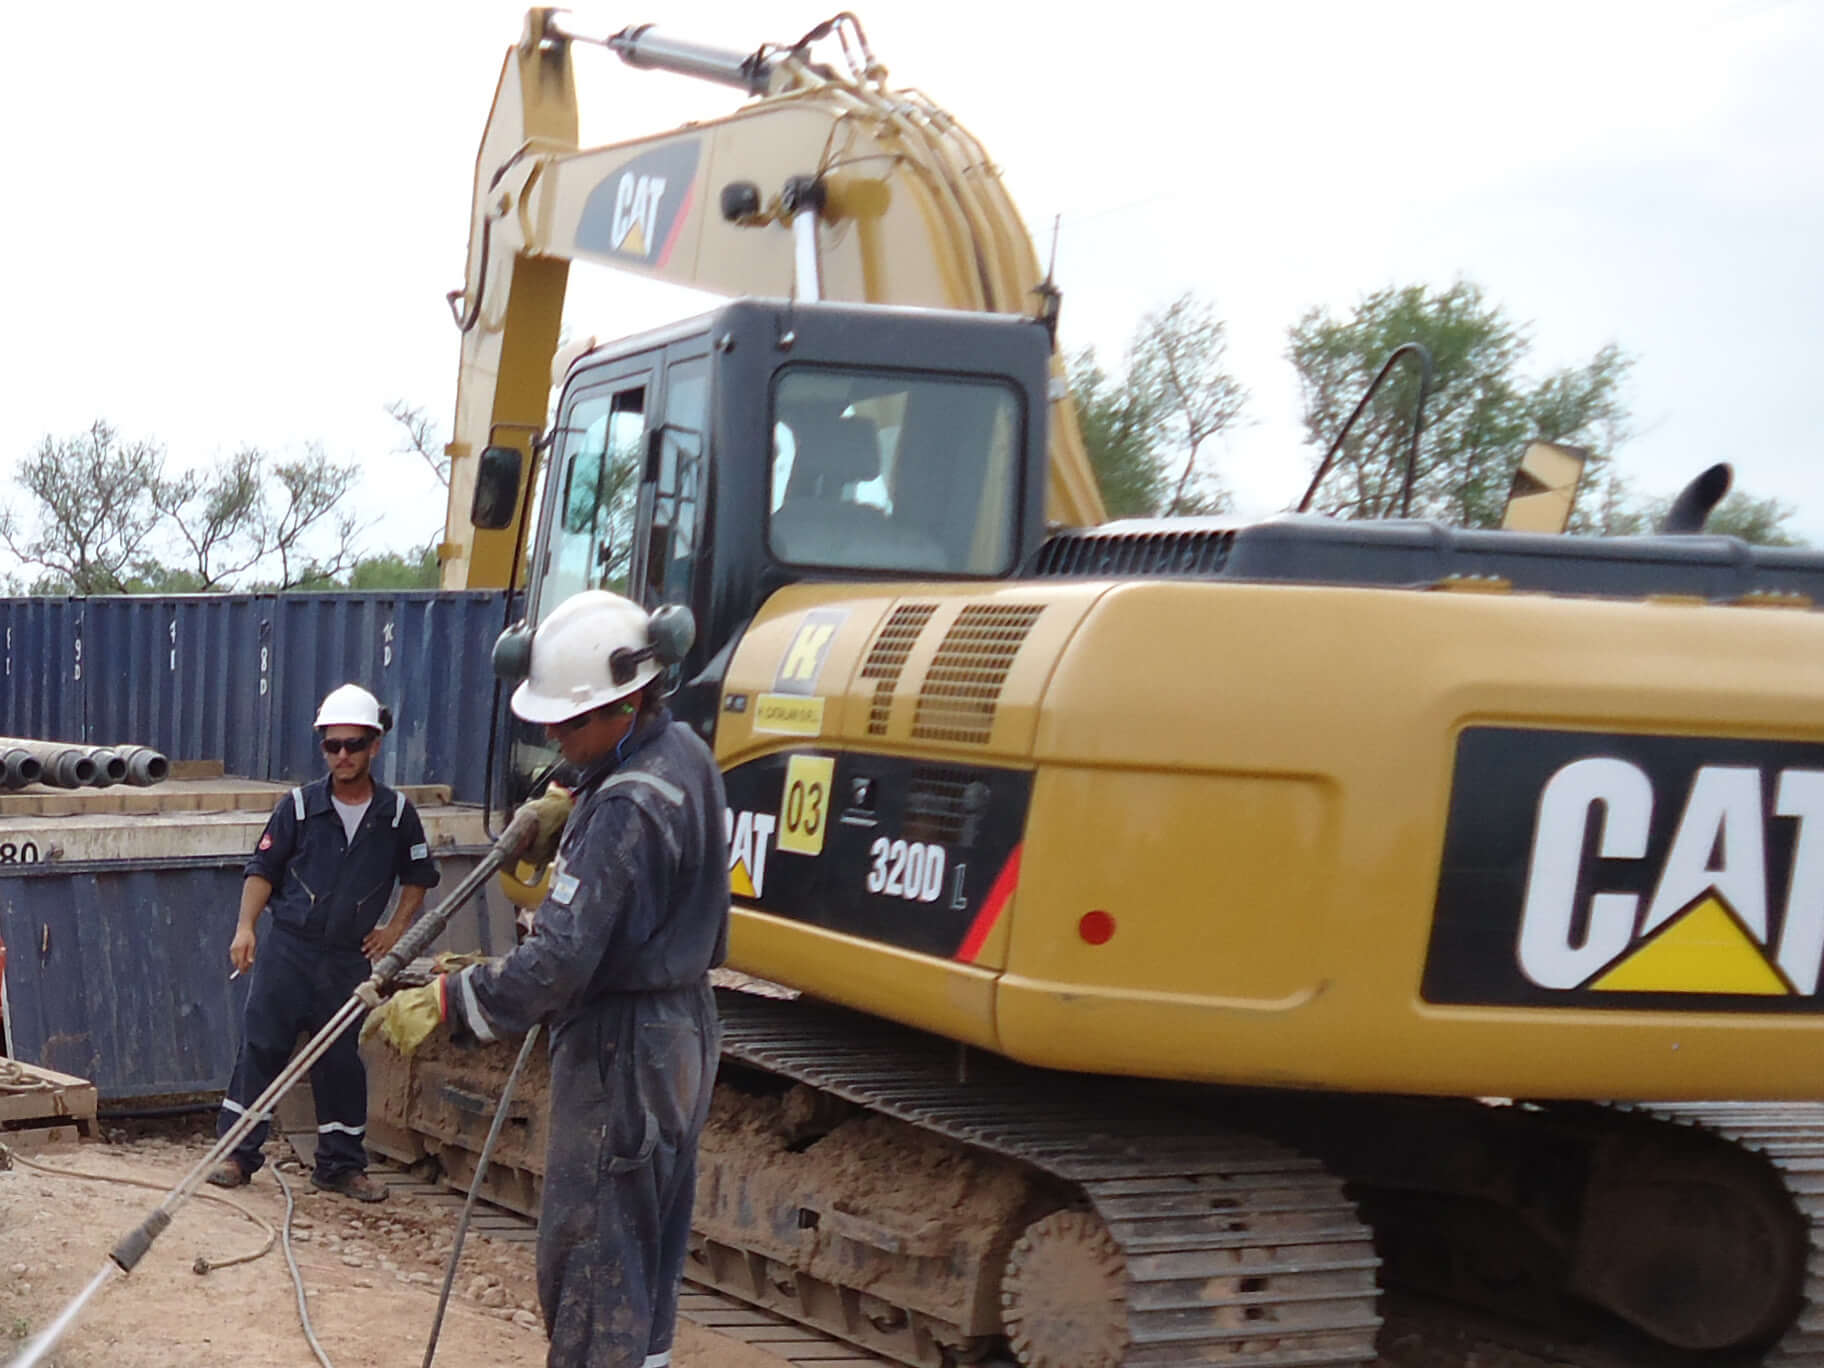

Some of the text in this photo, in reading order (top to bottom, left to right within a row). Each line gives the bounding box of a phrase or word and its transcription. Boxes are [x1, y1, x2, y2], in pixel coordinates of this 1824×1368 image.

[610, 172, 666, 255] CAT
[782, 623, 836, 681] K
[786, 779, 824, 836] 03
[0, 842, 39, 865] 80
[726, 807, 776, 899] AT
[866, 836, 946, 903] 320D
[1517, 757, 1824, 996] CAT
